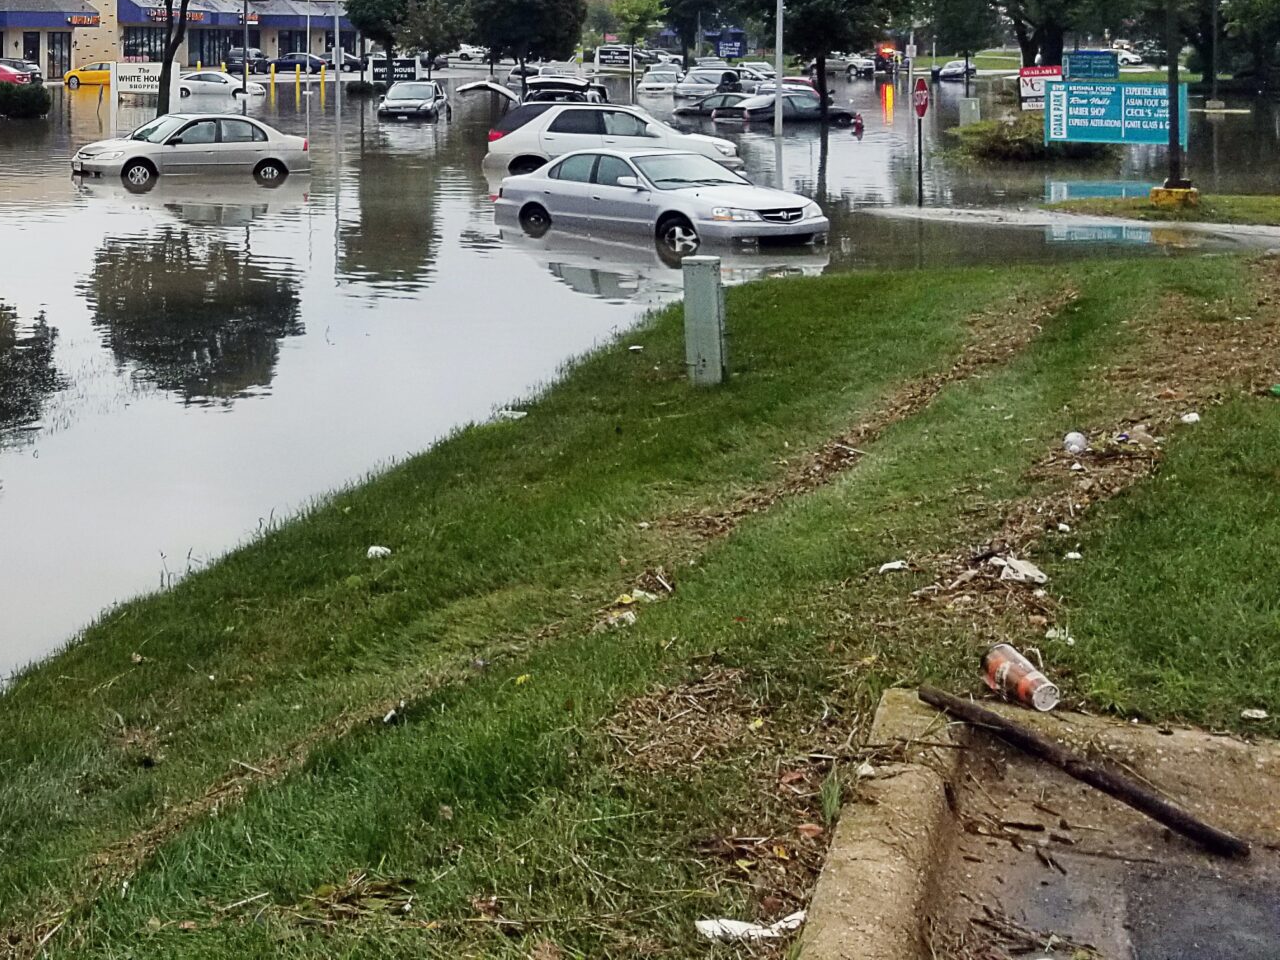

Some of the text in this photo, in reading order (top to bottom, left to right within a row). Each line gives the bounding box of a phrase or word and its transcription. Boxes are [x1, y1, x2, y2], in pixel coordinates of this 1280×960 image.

[1125, 87, 1167, 96] EXPERTISE HAIR
[915, 90, 928, 106] STOP
[1125, 98, 1143, 106] ASIAN
[1143, 98, 1159, 107] FOOT
[1053, 93, 1063, 136] ODANA PARK
[1069, 107, 1106, 116] BARBER SHOP
[1125, 108, 1152, 117] CECIL'S
[1068, 119, 1121, 128] EXPRESS ALTERATIONS
[1141, 120, 1158, 129] GLASS
